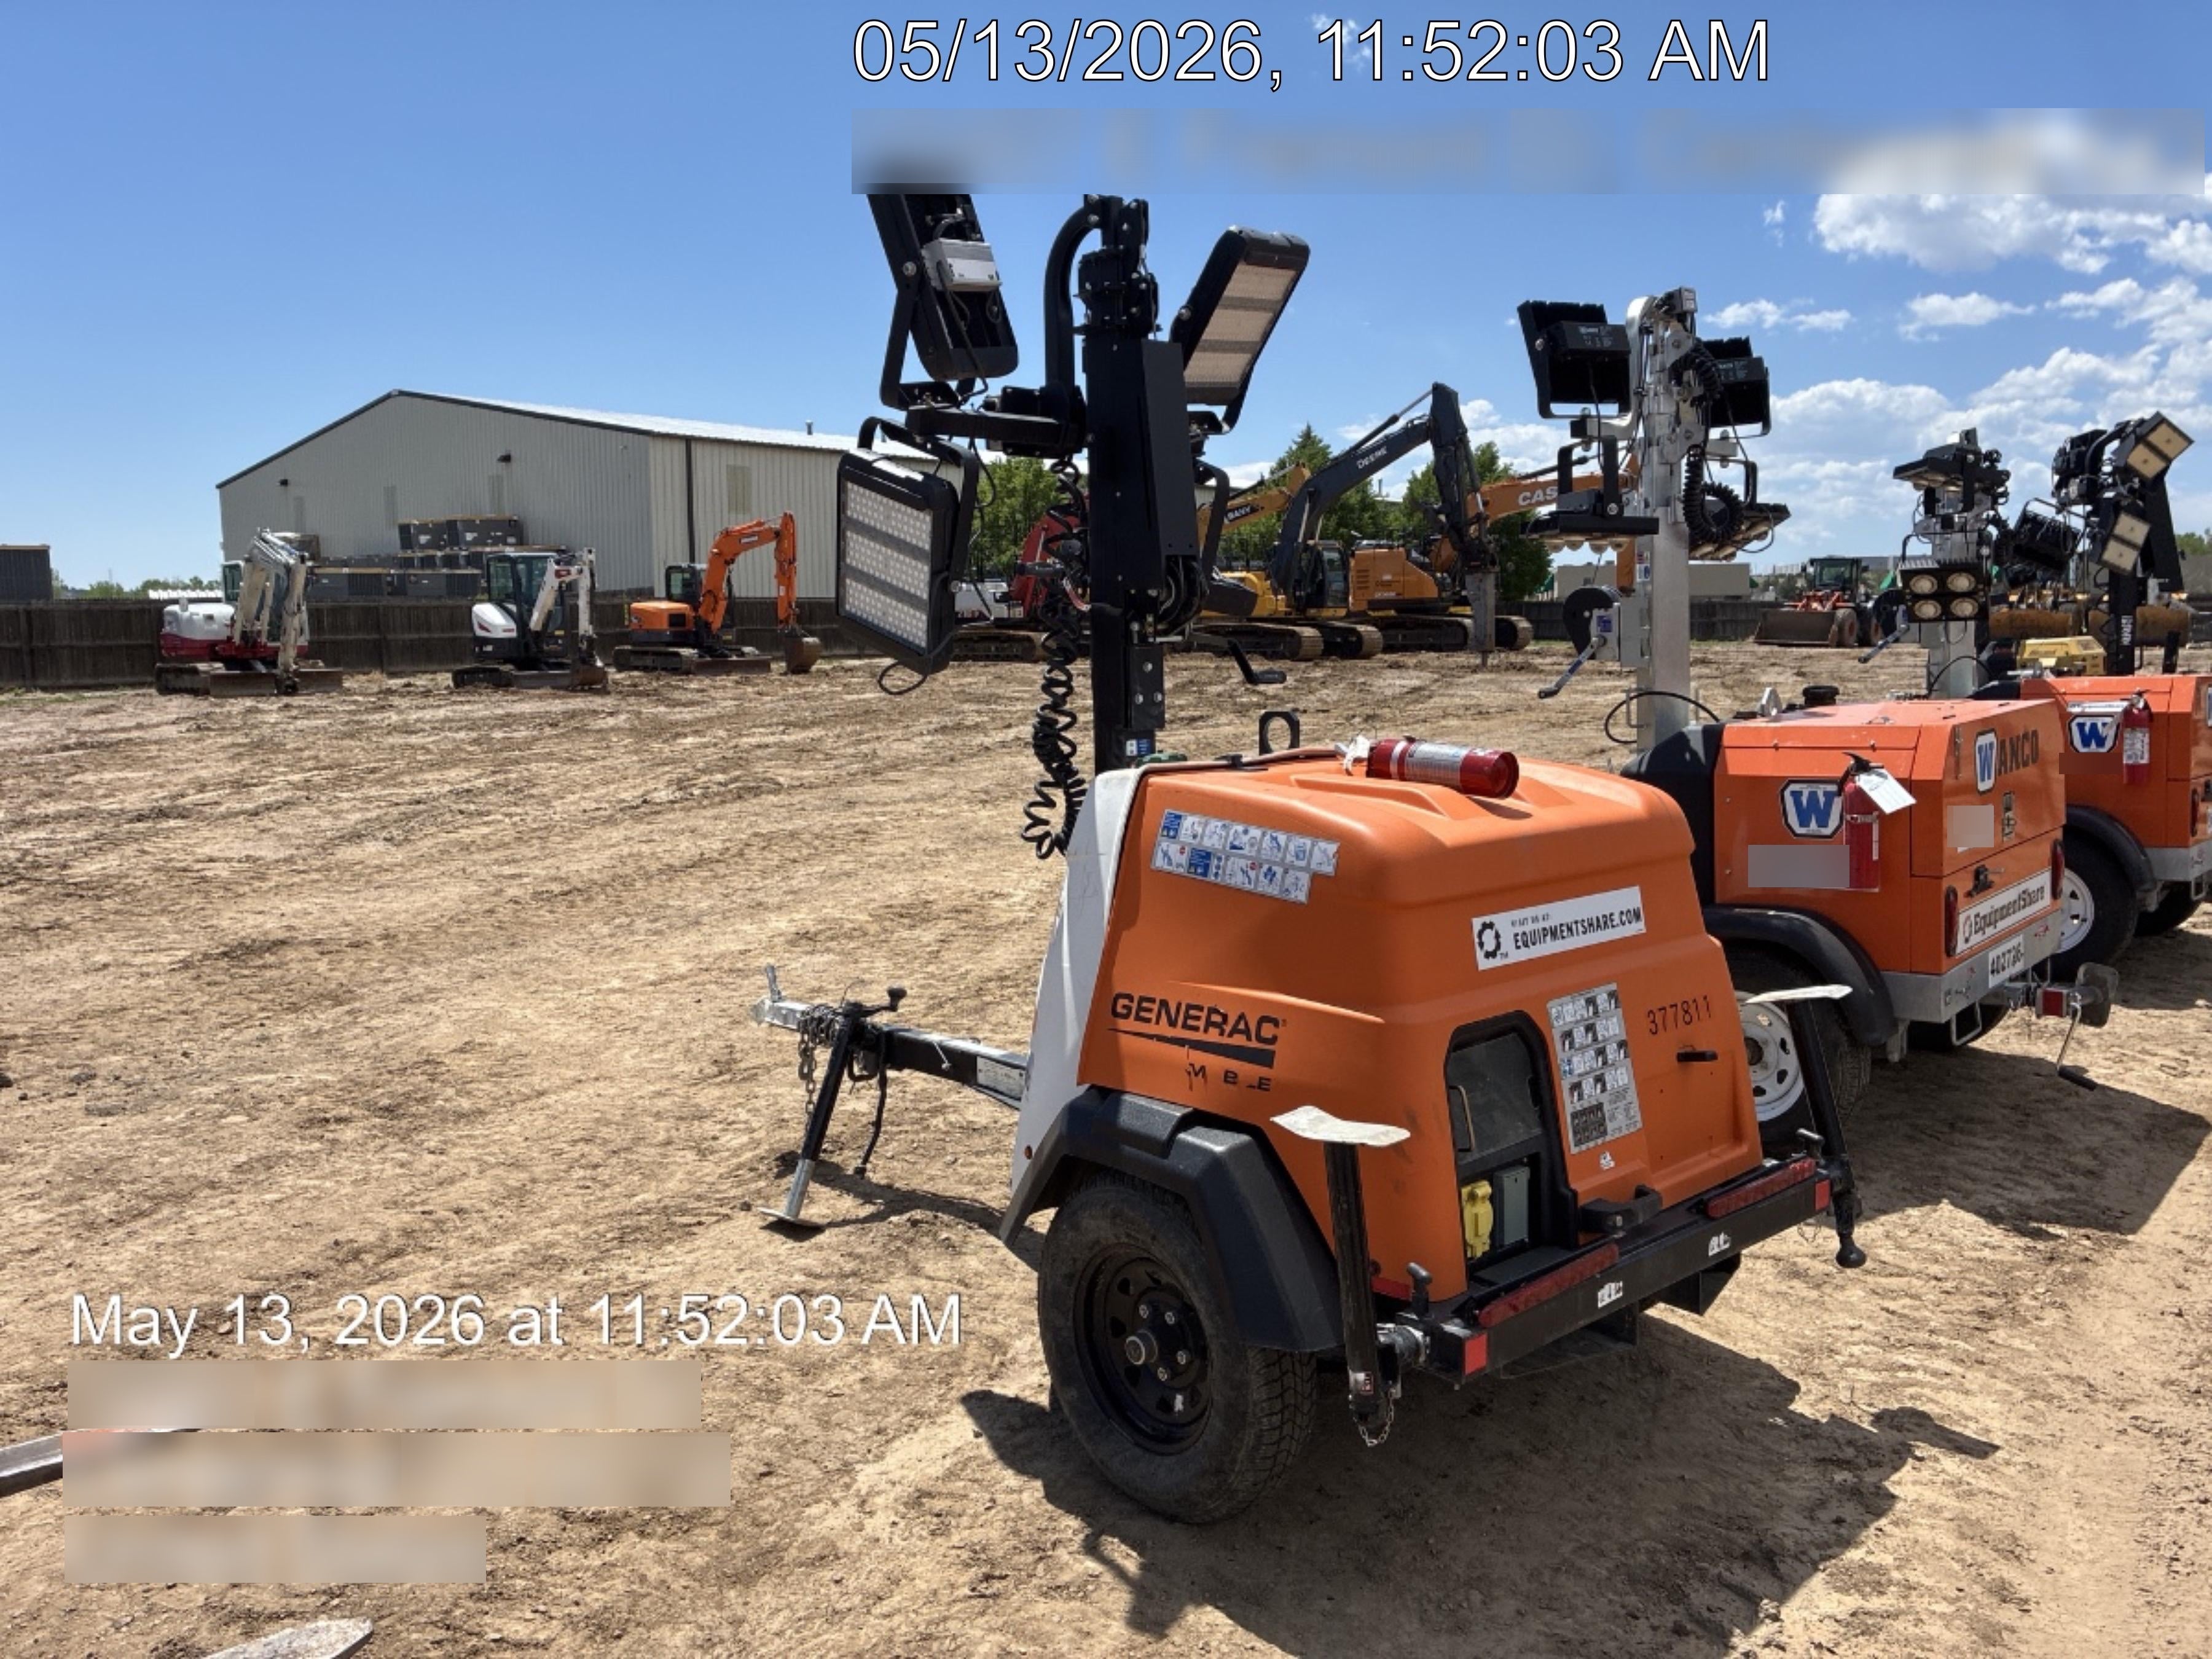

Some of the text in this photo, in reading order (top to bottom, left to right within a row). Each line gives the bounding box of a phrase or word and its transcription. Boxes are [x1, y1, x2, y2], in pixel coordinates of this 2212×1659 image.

[1518, 486, 1559, 506] CAS
[1790, 790, 1838, 828] W
[1513, 906, 1642, 950] EQUIPMENTSHARE.COM
[1974, 885, 2045, 935] EquipmentShare
[1111, 992, 1280, 1045] GENERAC
[1647, 995, 1711, 1035] 377811
